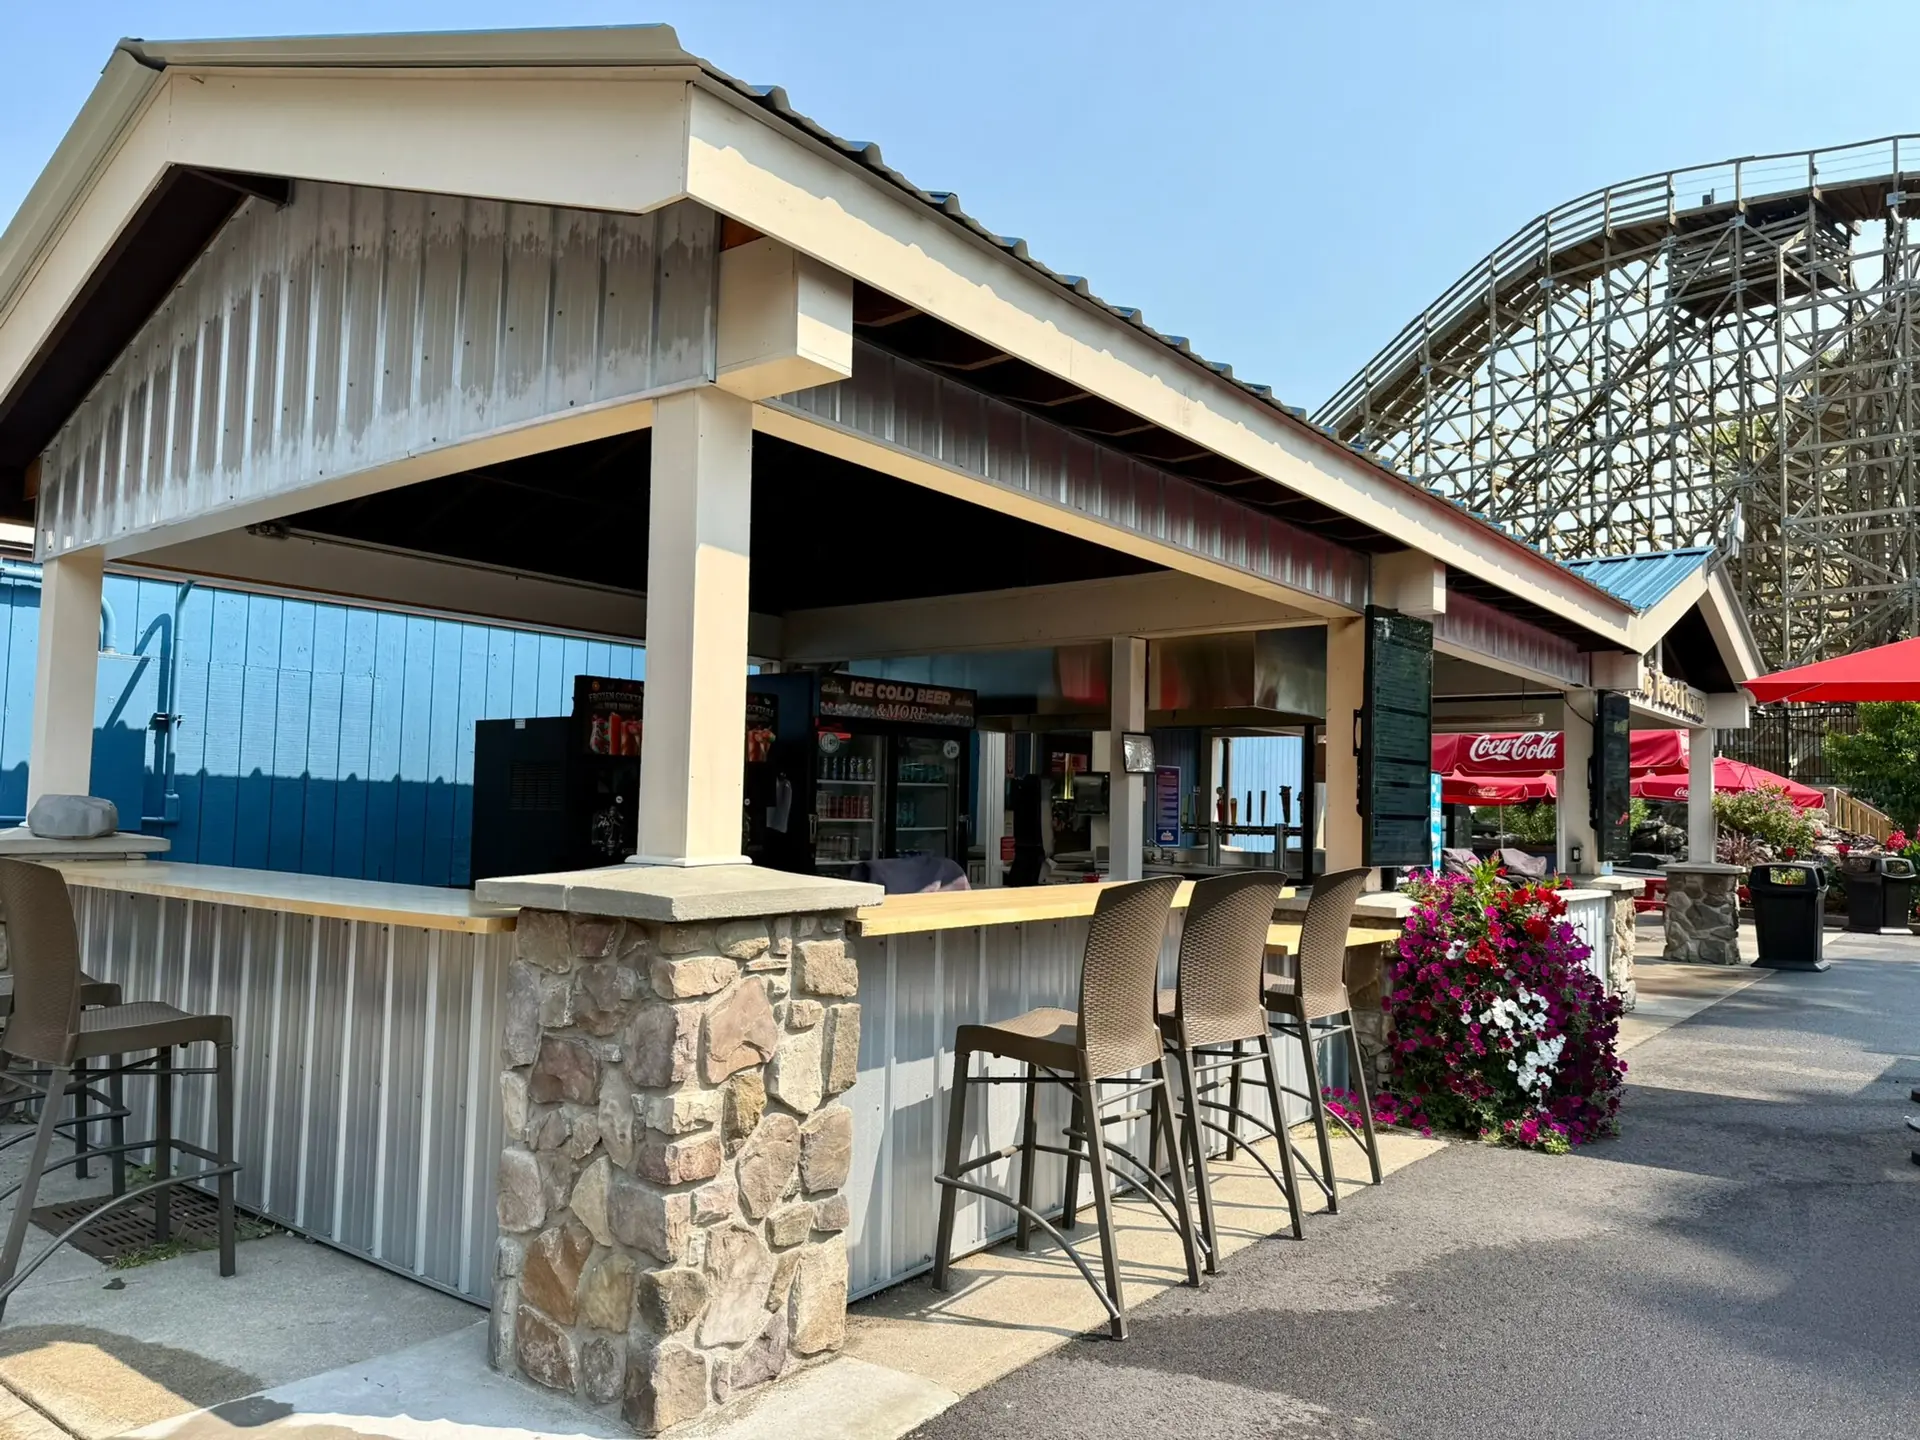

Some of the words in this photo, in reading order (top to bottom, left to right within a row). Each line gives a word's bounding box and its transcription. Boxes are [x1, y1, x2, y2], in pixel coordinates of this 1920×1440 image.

[849, 680, 874, 698] ICE
[876, 684, 914, 701] COLD
[915, 689, 952, 706] BEER
[876, 703, 928, 721] &MORE
[1469, 731, 1559, 762] Coca-Cola
